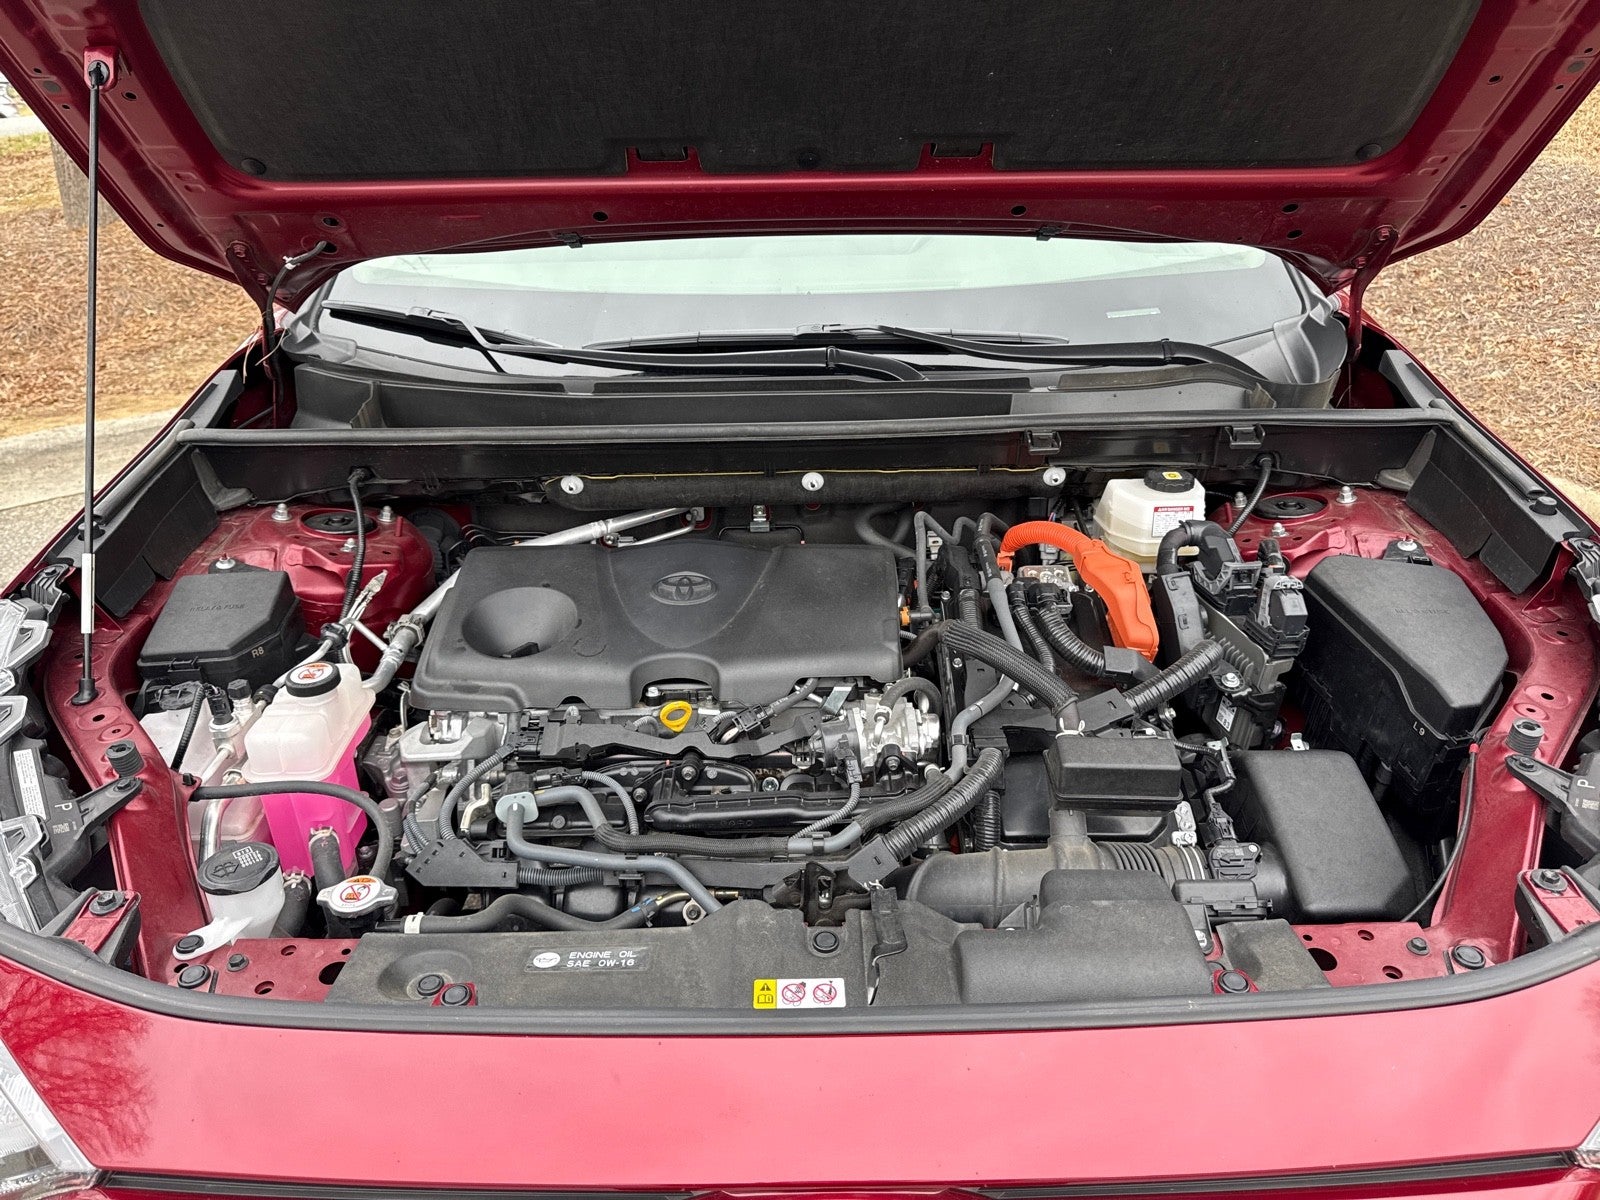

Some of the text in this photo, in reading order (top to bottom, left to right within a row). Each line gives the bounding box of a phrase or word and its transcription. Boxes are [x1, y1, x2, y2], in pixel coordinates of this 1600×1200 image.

[251, 646, 265, 658] R8
[568, 950, 637, 959] ENGINE OIL
[566, 958, 635, 967] SAE 0W-16
